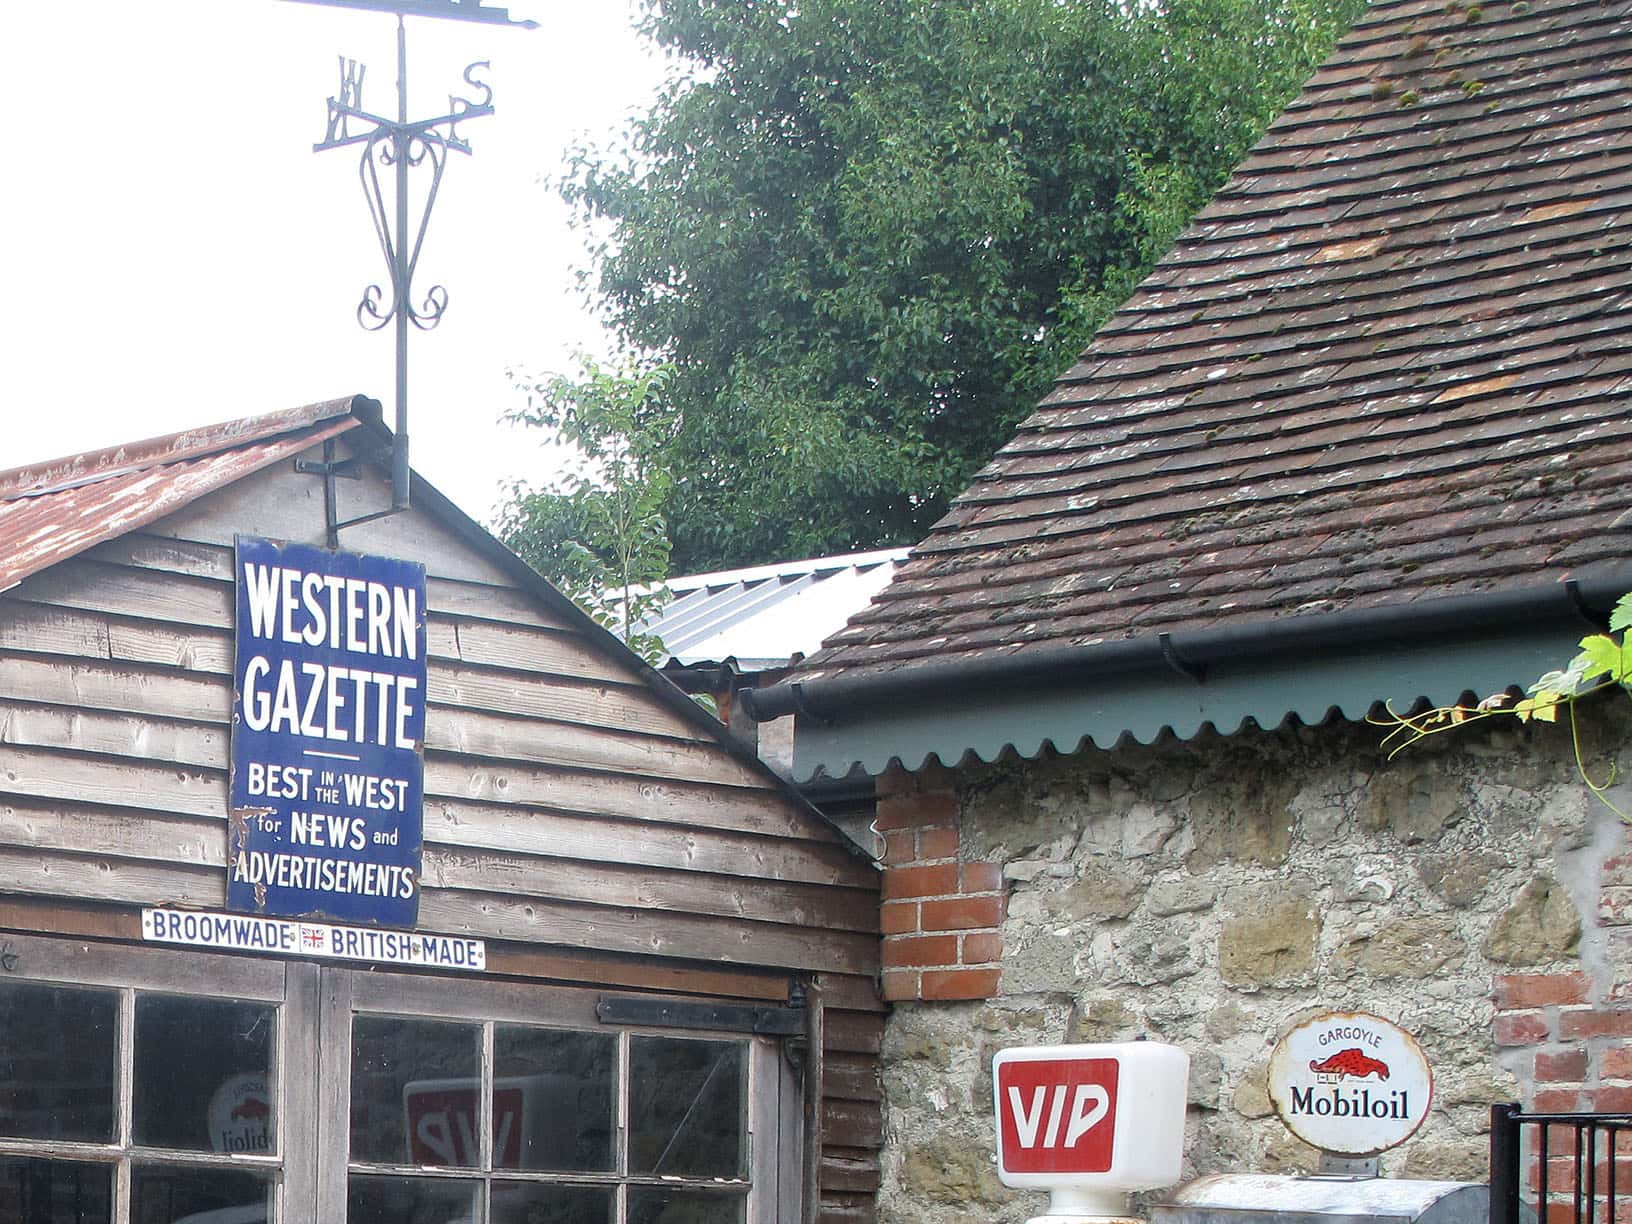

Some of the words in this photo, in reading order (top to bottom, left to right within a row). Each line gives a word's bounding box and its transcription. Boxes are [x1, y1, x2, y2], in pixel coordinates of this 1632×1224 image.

[337, 55, 366, 112] W
[463, 60, 493, 106] S
[244, 562, 416, 660] WESTERN
[242, 655, 417, 750] GAZETTE
[248, 762, 312, 801] BEST
[315, 787, 339, 805] THE
[321, 771, 334, 785] IN
[344, 773, 408, 812] WEST
[257, 814, 281, 834] for
[290, 812, 366, 851] NEWS
[373, 829, 398, 847] and
[234, 850, 414, 900] ADVERTISEMENTS
[153, 911, 291, 949] BROOMWADE
[1319, 1027, 1382, 1048] GARGOYLE
[1008, 1083, 1109, 1149] VIP
[1290, 1086, 1409, 1119] Mobiloil
